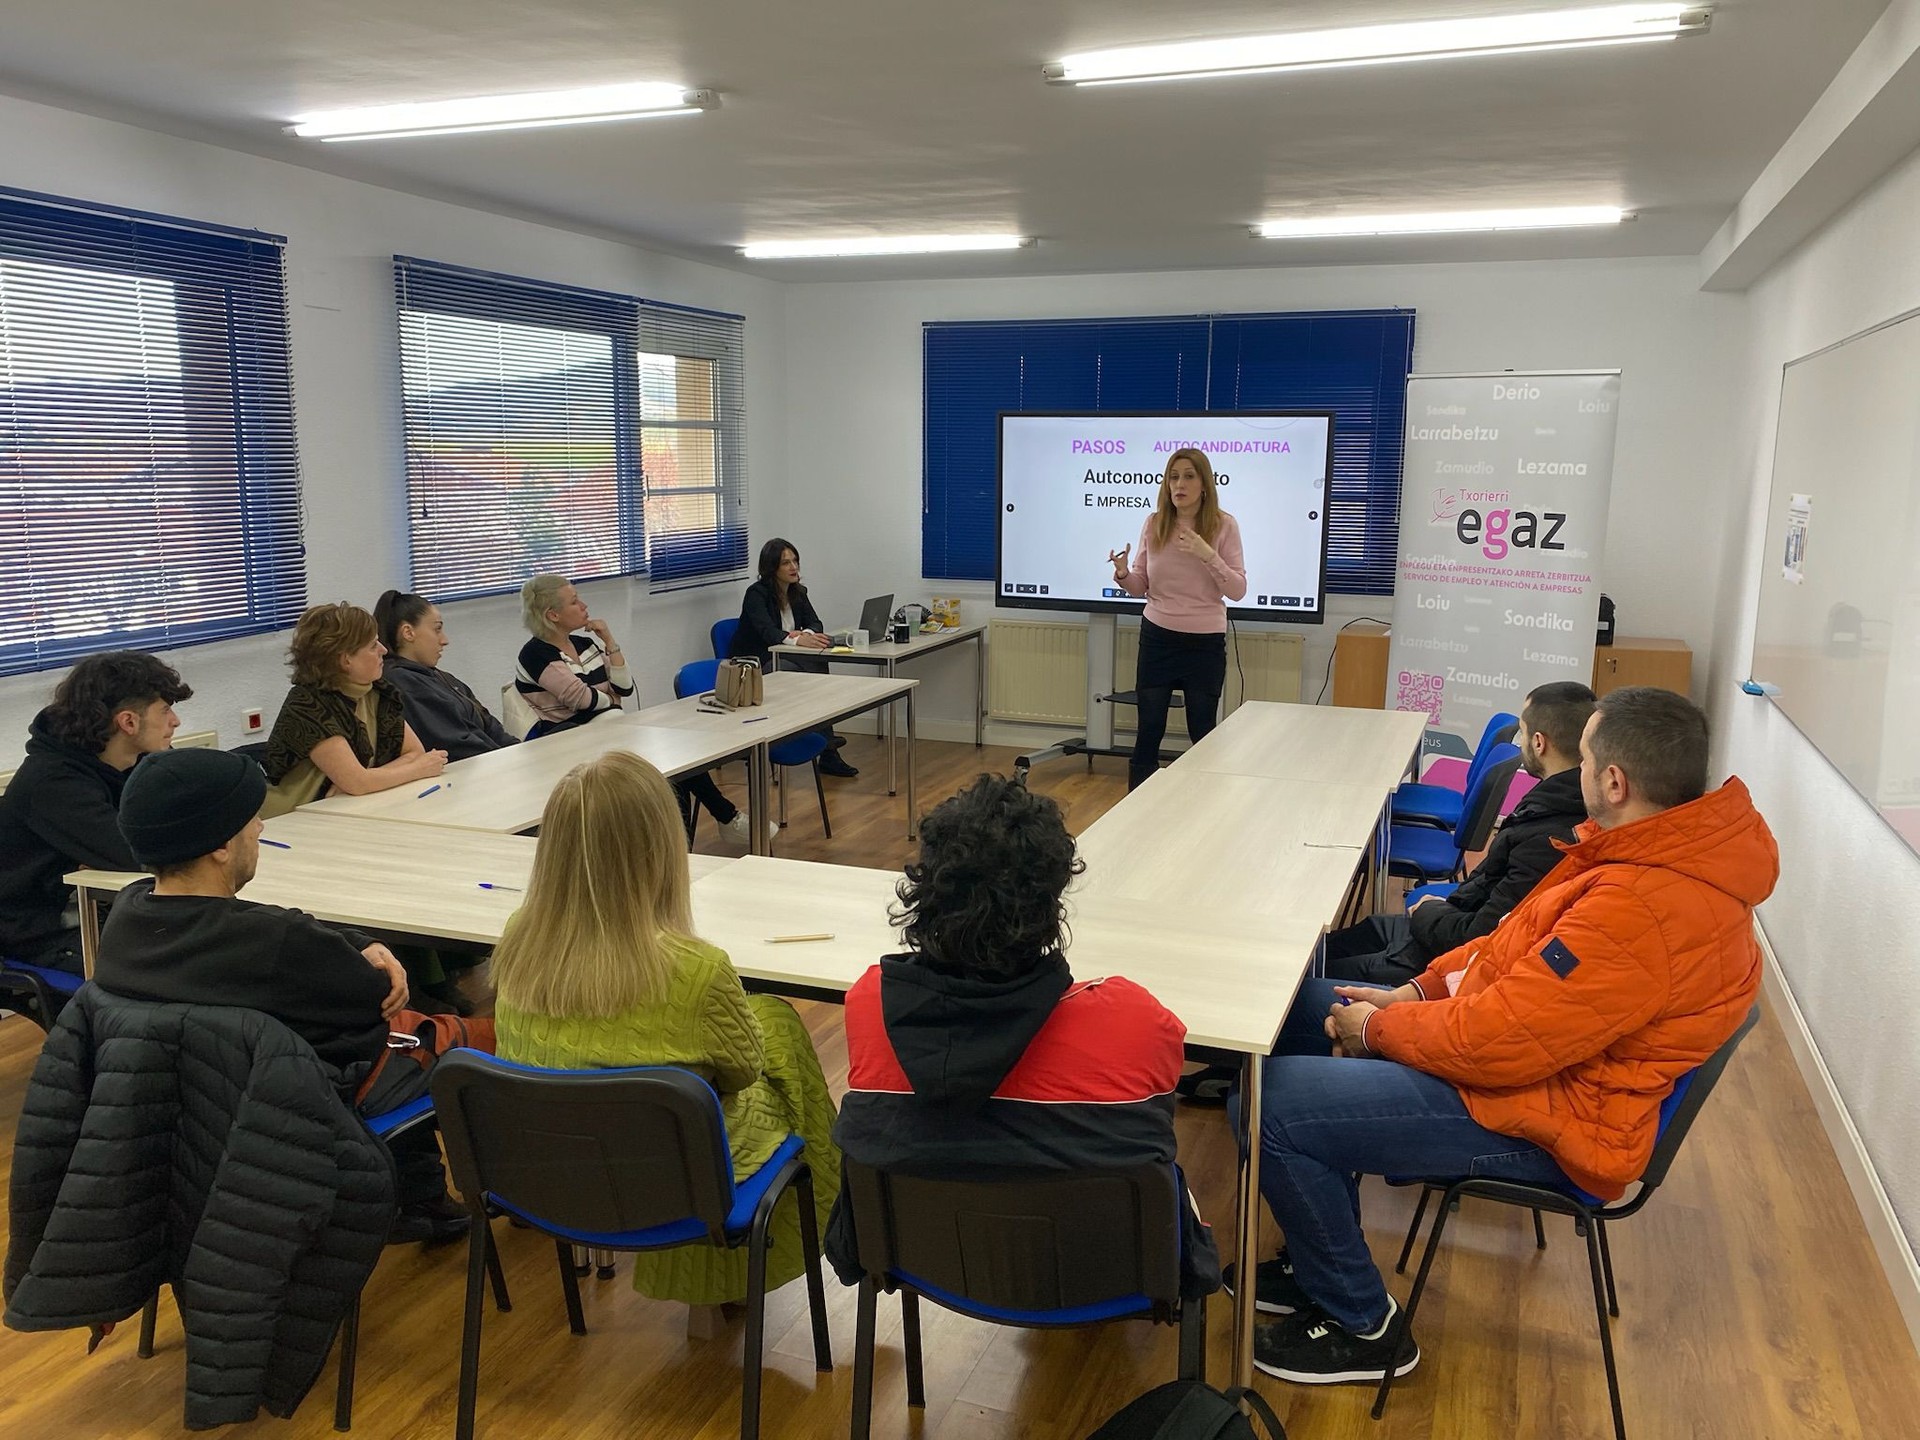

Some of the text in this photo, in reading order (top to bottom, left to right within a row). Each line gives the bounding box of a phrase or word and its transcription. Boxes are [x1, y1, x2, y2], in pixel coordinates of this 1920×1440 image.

[1492, 382, 1541, 401] Derio
[1577, 399, 1610, 414] Loiu
[1410, 424, 1499, 441] Larrabetzu
[1072, 440, 1126, 454] PASOS
[1153, 440, 1291, 454] AUTOCANDIDATURA
[1434, 460, 1495, 475] Zamudio
[1517, 458, 1588, 476] Lezama
[1458, 488, 1510, 503] Txorierri
[1456, 508, 1567, 561] egaz
[1448, 564, 1513, 577] ENPRESENTZAKO
[1514, 569, 1546, 579] ARRETA
[1547, 571, 1592, 583] ZERBITZUA
[1403, 572, 1438, 582] SERVICIO
[1439, 575, 1450, 583] DE
[1451, 576, 1482, 586] EMPLEO
[1483, 578, 1489, 586] Y
[1532, 583, 1539, 591] A
[1540, 583, 1583, 595] EMPRESAS
[1416, 593, 1451, 611] Loiu
[1504, 609, 1574, 632] Sondika
[1400, 635, 1469, 653] Larrabetzu
[1523, 648, 1579, 667] Lezama
[1446, 666, 1520, 691] Zamudio
